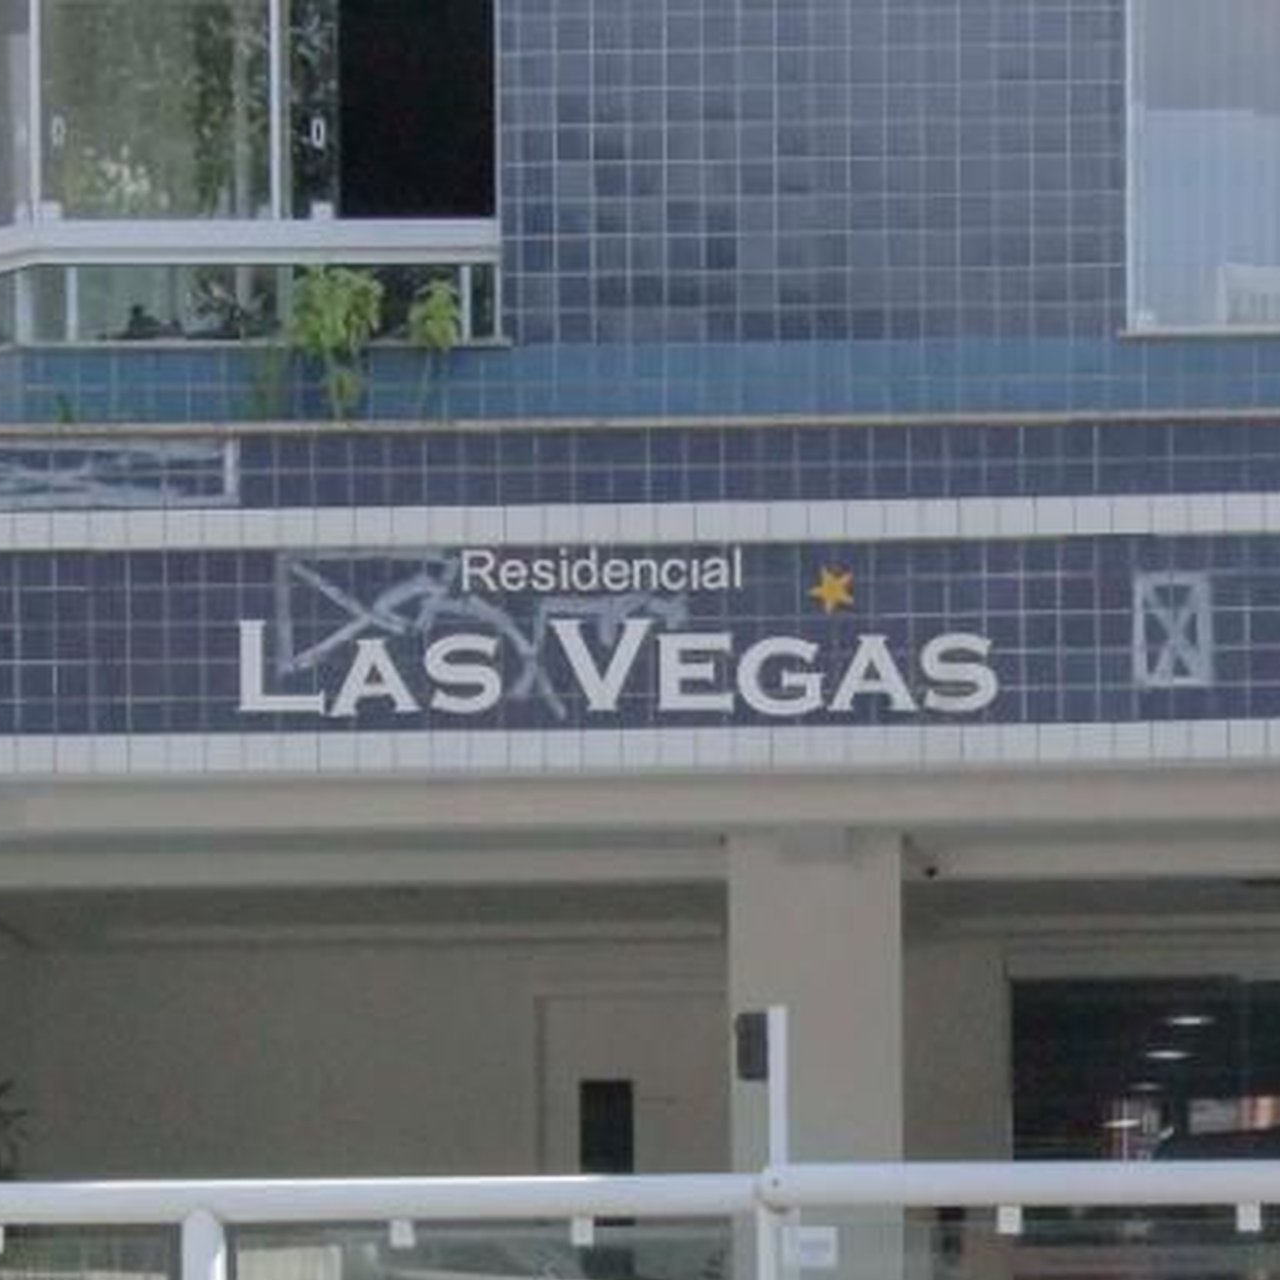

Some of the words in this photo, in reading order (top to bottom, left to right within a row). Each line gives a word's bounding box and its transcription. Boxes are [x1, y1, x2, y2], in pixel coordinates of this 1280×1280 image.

[461, 547, 743, 592] Residencial
[238, 618, 503, 717] LAS
[550, 617, 999, 716] VEGAS
